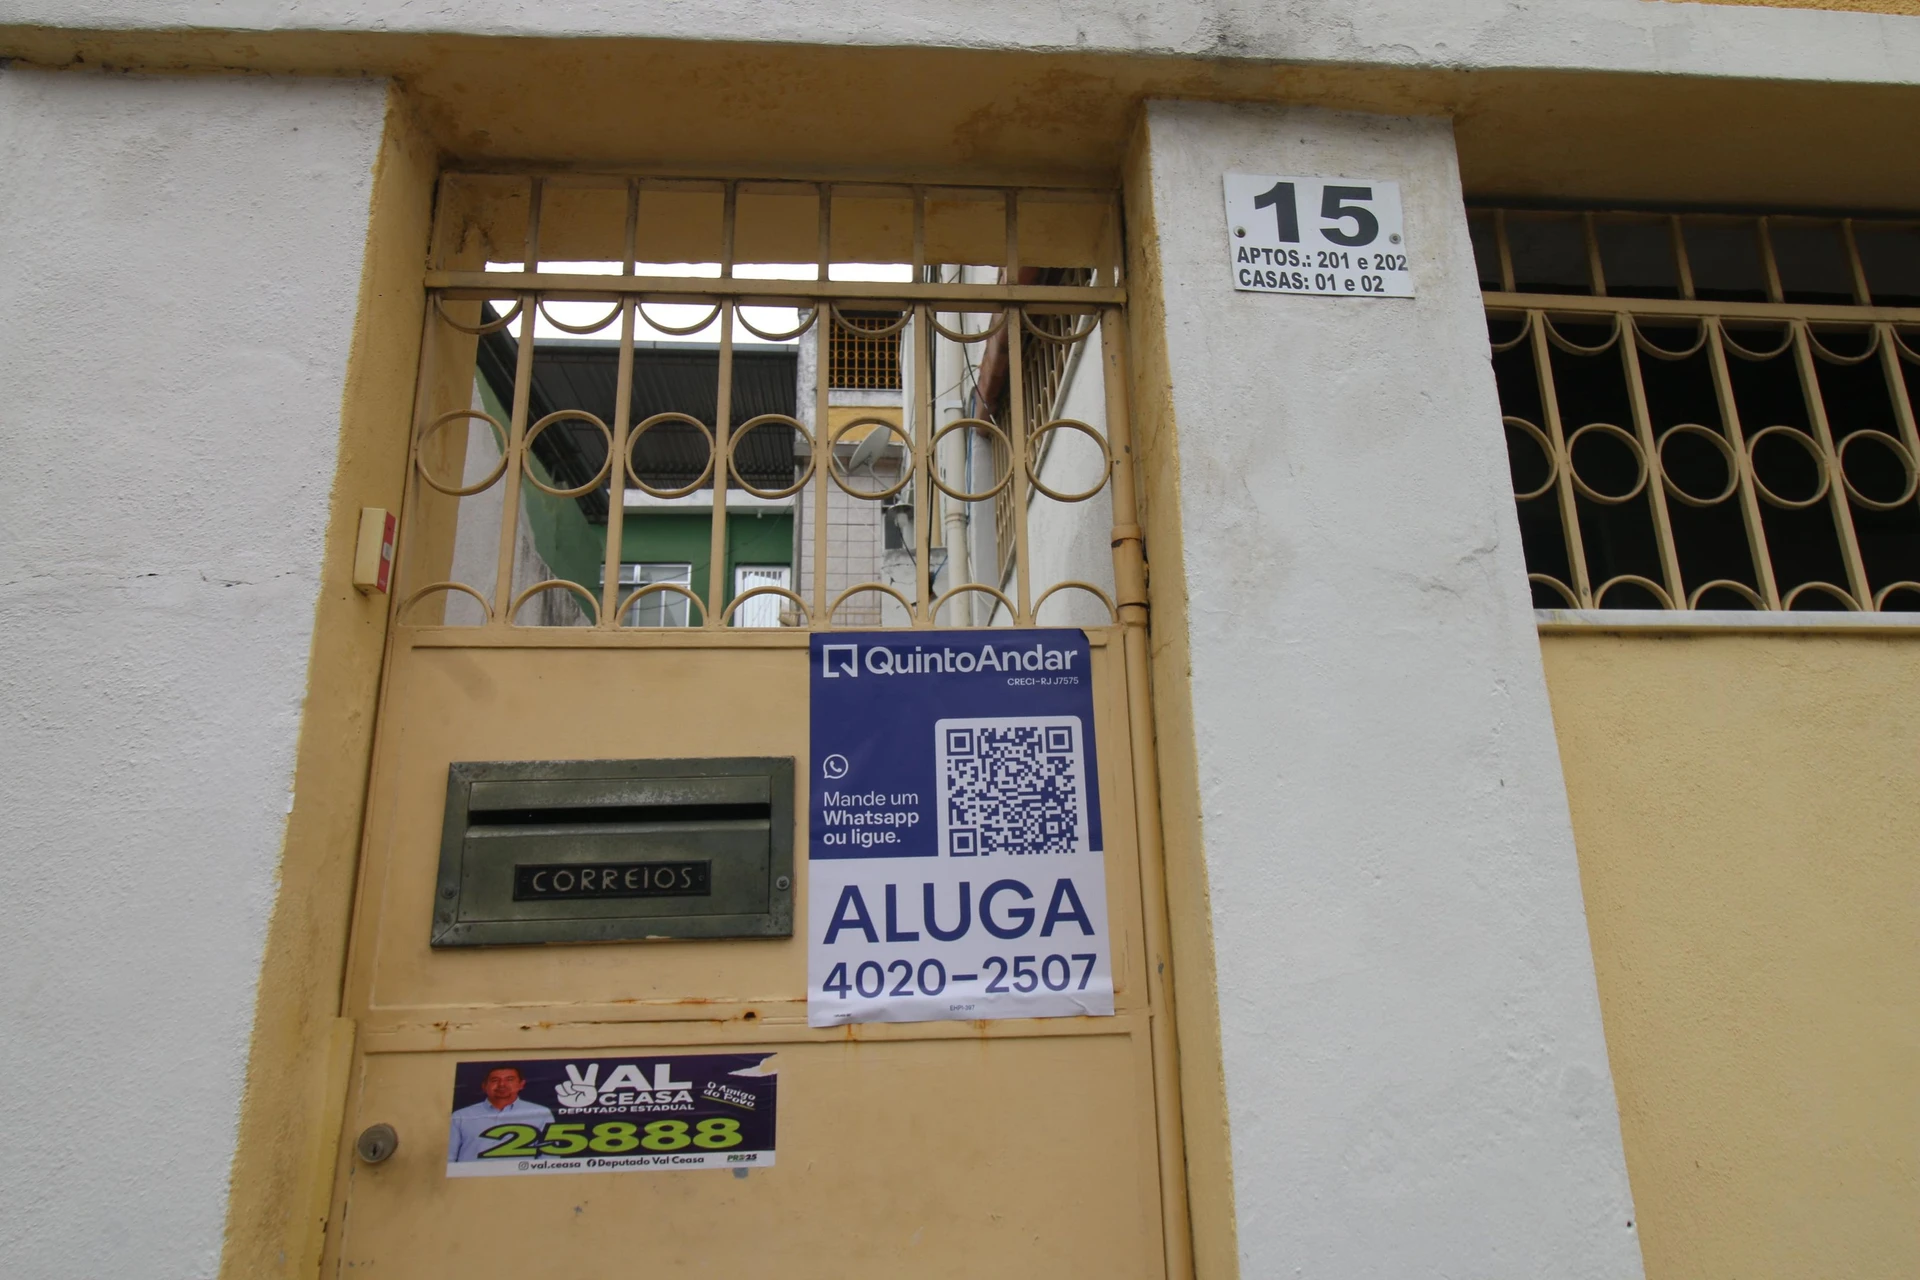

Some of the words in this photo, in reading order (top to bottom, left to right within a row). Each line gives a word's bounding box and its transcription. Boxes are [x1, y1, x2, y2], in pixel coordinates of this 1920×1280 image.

[1253, 181, 1379, 247] 15
[1237, 246, 1312, 268] APTOS.:
[1317, 250, 1350, 269] 201
[1357, 257, 1369, 270] e
[1373, 253, 1409, 271] 202
[1239, 268, 1310, 290] CASAS:
[1315, 273, 1336, 291] 01
[1344, 277, 1356, 291] e
[1361, 274, 1385, 292] 02
[864, 643, 1078, 676] QuintoAndar
[1007, 677, 1052, 686] CRECI-RJ
[1053, 676, 1079, 685] J7575
[823, 790, 887, 807] Mande
[890, 792, 919, 806] um
[823, 809, 920, 828] Whatsapp
[823, 832, 847, 845] ou
[851, 828, 902, 848] ligue.
[531, 865, 693, 892] CORREIOS
[822, 878, 1096, 945] ALUGA
[822, 953, 1098, 1000] 4020-2507
[556, 1063, 693, 1098] VAL
[707, 1081, 717, 1089] O
[718, 1085, 756, 1100] Amigo
[598, 1089, 694, 1106] CEASA
[703, 1088, 720, 1097] do
[723, 1093, 755, 1107] Povo
[558, 1105, 627, 1115] DEPUTADO
[630, 1103, 695, 1112] ESTADUAL
[480, 1117, 743, 1158] 25888
[530, 1160, 581, 1170] val.ceasa
[598, 1158, 650, 1169] Deputado
[652, 1156, 670, 1165] Val
[672, 1155, 704, 1165] Ceasa
